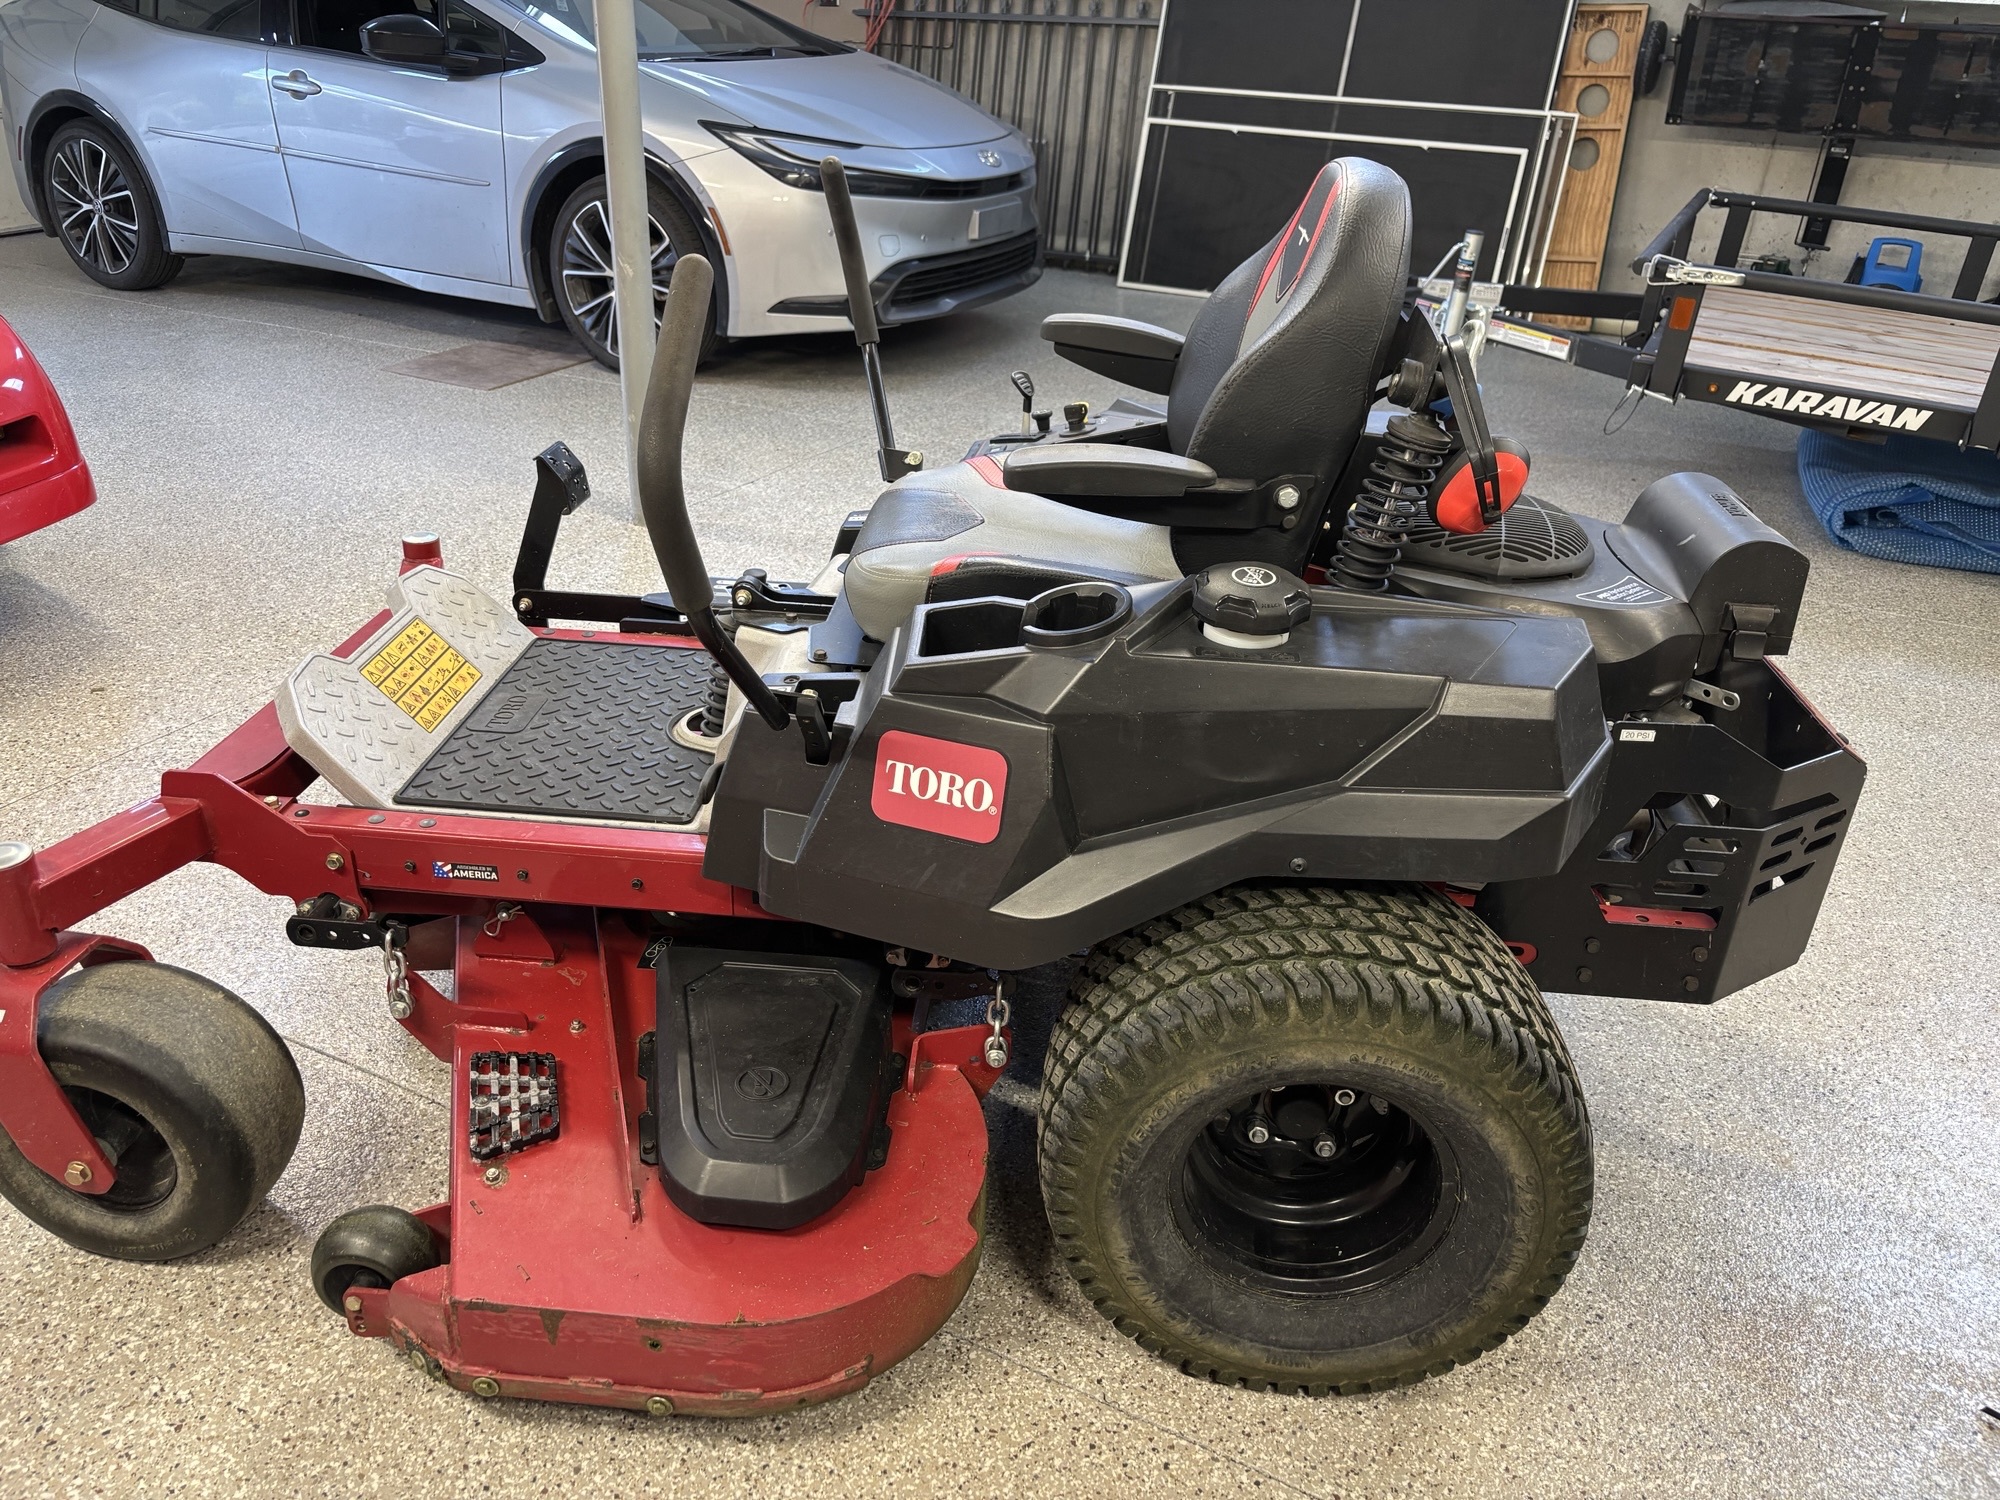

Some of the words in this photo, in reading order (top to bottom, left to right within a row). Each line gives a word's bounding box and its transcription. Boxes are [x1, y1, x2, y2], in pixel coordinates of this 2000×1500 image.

[1725, 380, 1934, 432] KARAVAN
[485, 695, 528, 729] TORO
[1625, 731, 1635, 739] 20
[1636, 732, 1650, 740] PSI
[453, 869, 498, 880] AMERICA
[1401, 1062, 1440, 1082] RATING
